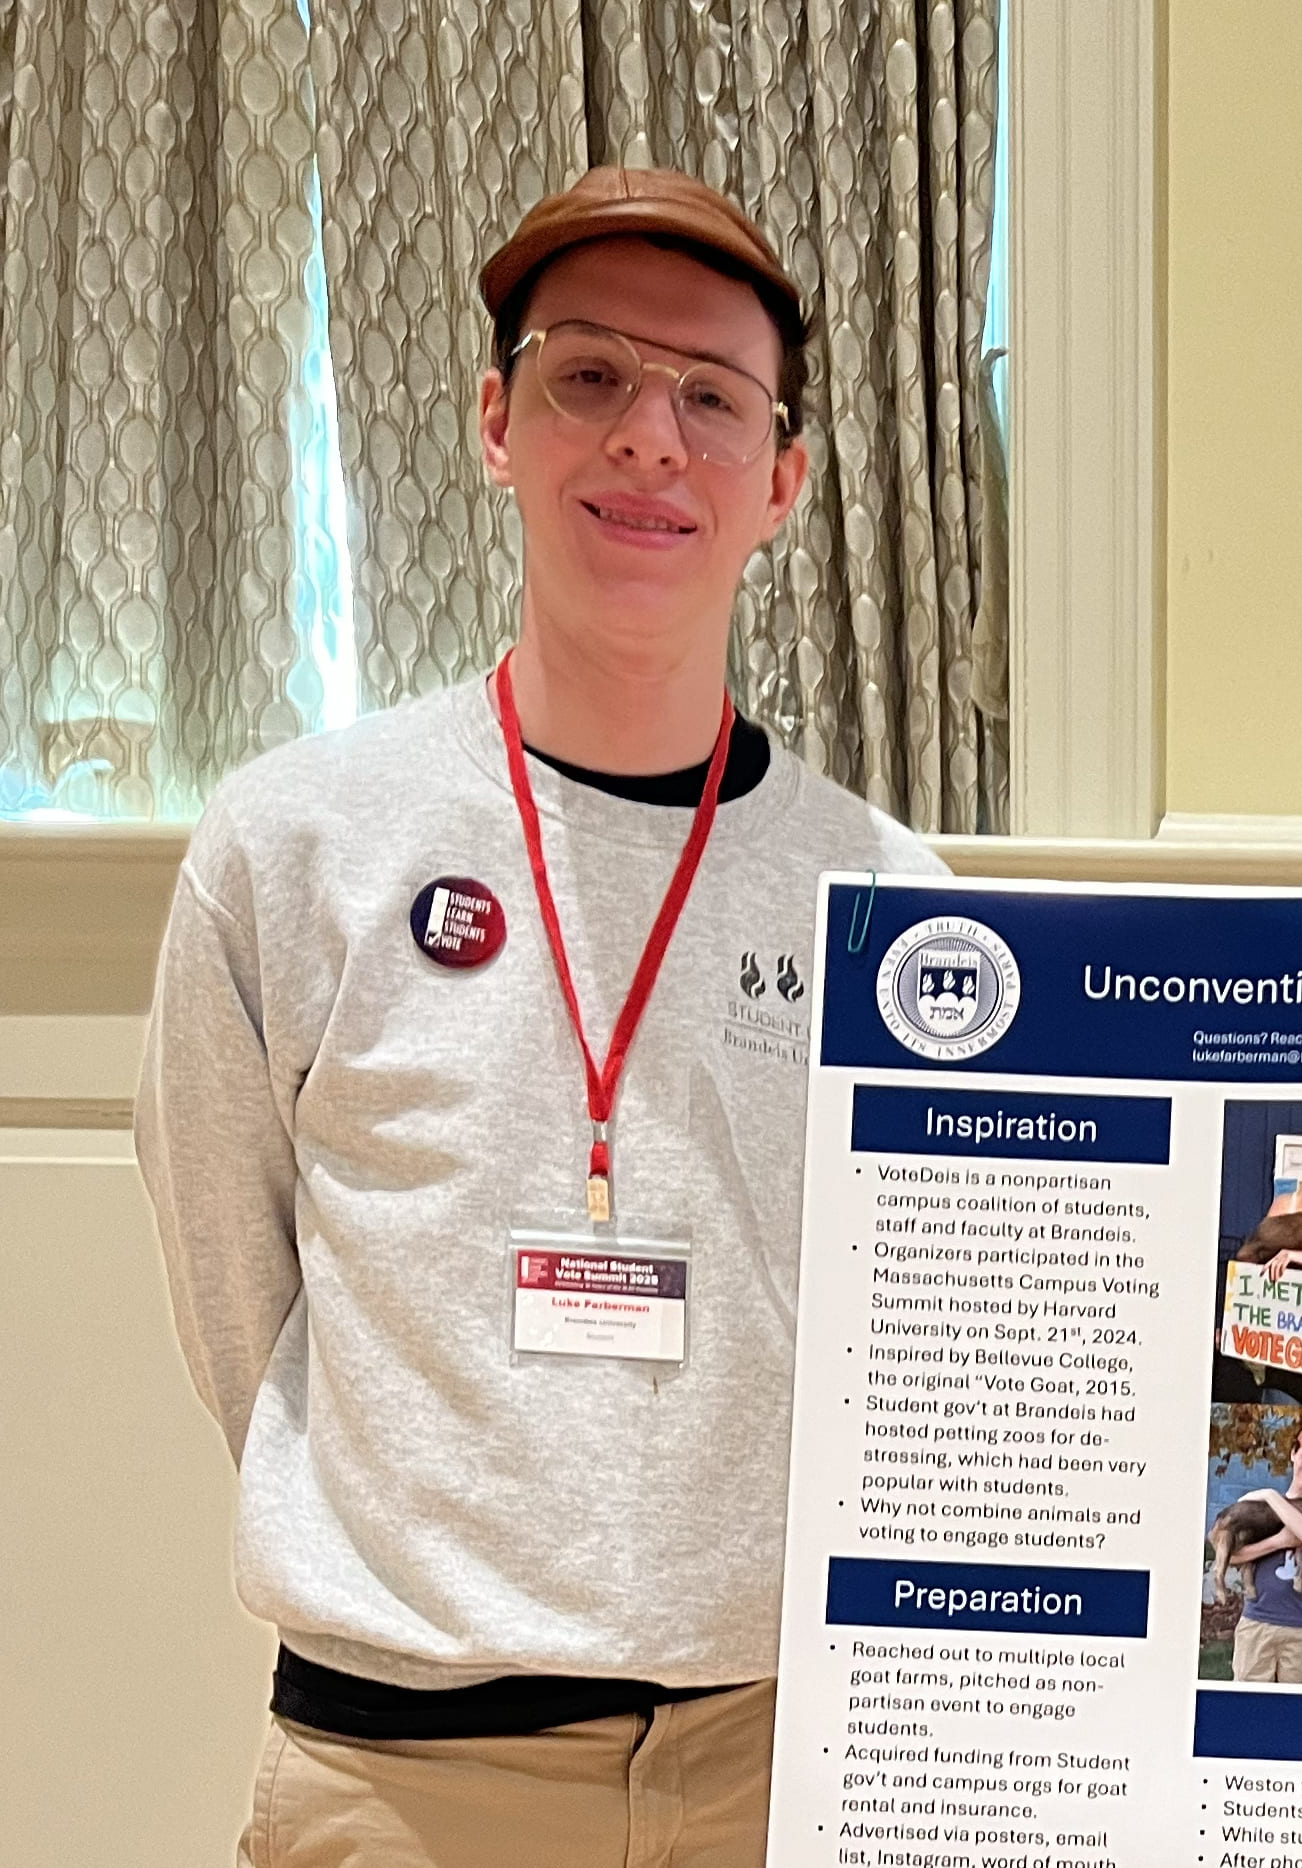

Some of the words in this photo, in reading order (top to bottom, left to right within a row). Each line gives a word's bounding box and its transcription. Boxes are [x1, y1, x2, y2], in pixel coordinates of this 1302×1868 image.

[450, 892, 492, 914] STUDENTS
[446, 906, 473, 924] LEARN
[441, 934, 462, 951] VOTE
[444, 920, 485, 943] STUDENTS
[728, 1001, 801, 1037] STUDENT
[1193, 1030, 1268, 1046] Questions?
[926, 1107, 1097, 1144] Inspiration
[877, 1165, 960, 1184] VoteDeis
[965, 1171, 980, 1185] is
[985, 1174, 996, 1186] a
[1001, 1174, 1111, 1191] nonpartisan
[876, 1194, 951, 1212] campus
[956, 1196, 1036, 1213] coalition
[1041, 1198, 1059, 1214] of
[1065, 1200, 1150, 1220] students,
[555, 1267, 582, 1280] Vote
[583, 1269, 627, 1284] Summit
[560, 1257, 608, 1272] National
[609, 1261, 653, 1274] Student
[1239, 1275, 1254, 1297] I
[551, 1297, 580, 1308] Luke
[1233, 1303, 1272, 1327] THE
[894, 1579, 1082, 1617] Preparation
[852, 1641, 934, 1660] Reached
[939, 1647, 969, 1661] out
[975, 1648, 993, 1662] to
[998, 1649, 1075, 1668] multiple
[1080, 1652, 1125, 1668] local
[850, 1670, 889, 1686] goat
[896, 1668, 953, 1689] farms,
[959, 1673, 1030, 1690] pitched
[1035, 1678, 1056, 1690] as
[1062, 1680, 1103, 1692] non-
[847, 1720, 933, 1737] students.
[1225, 1775, 1295, 1793] Weston
